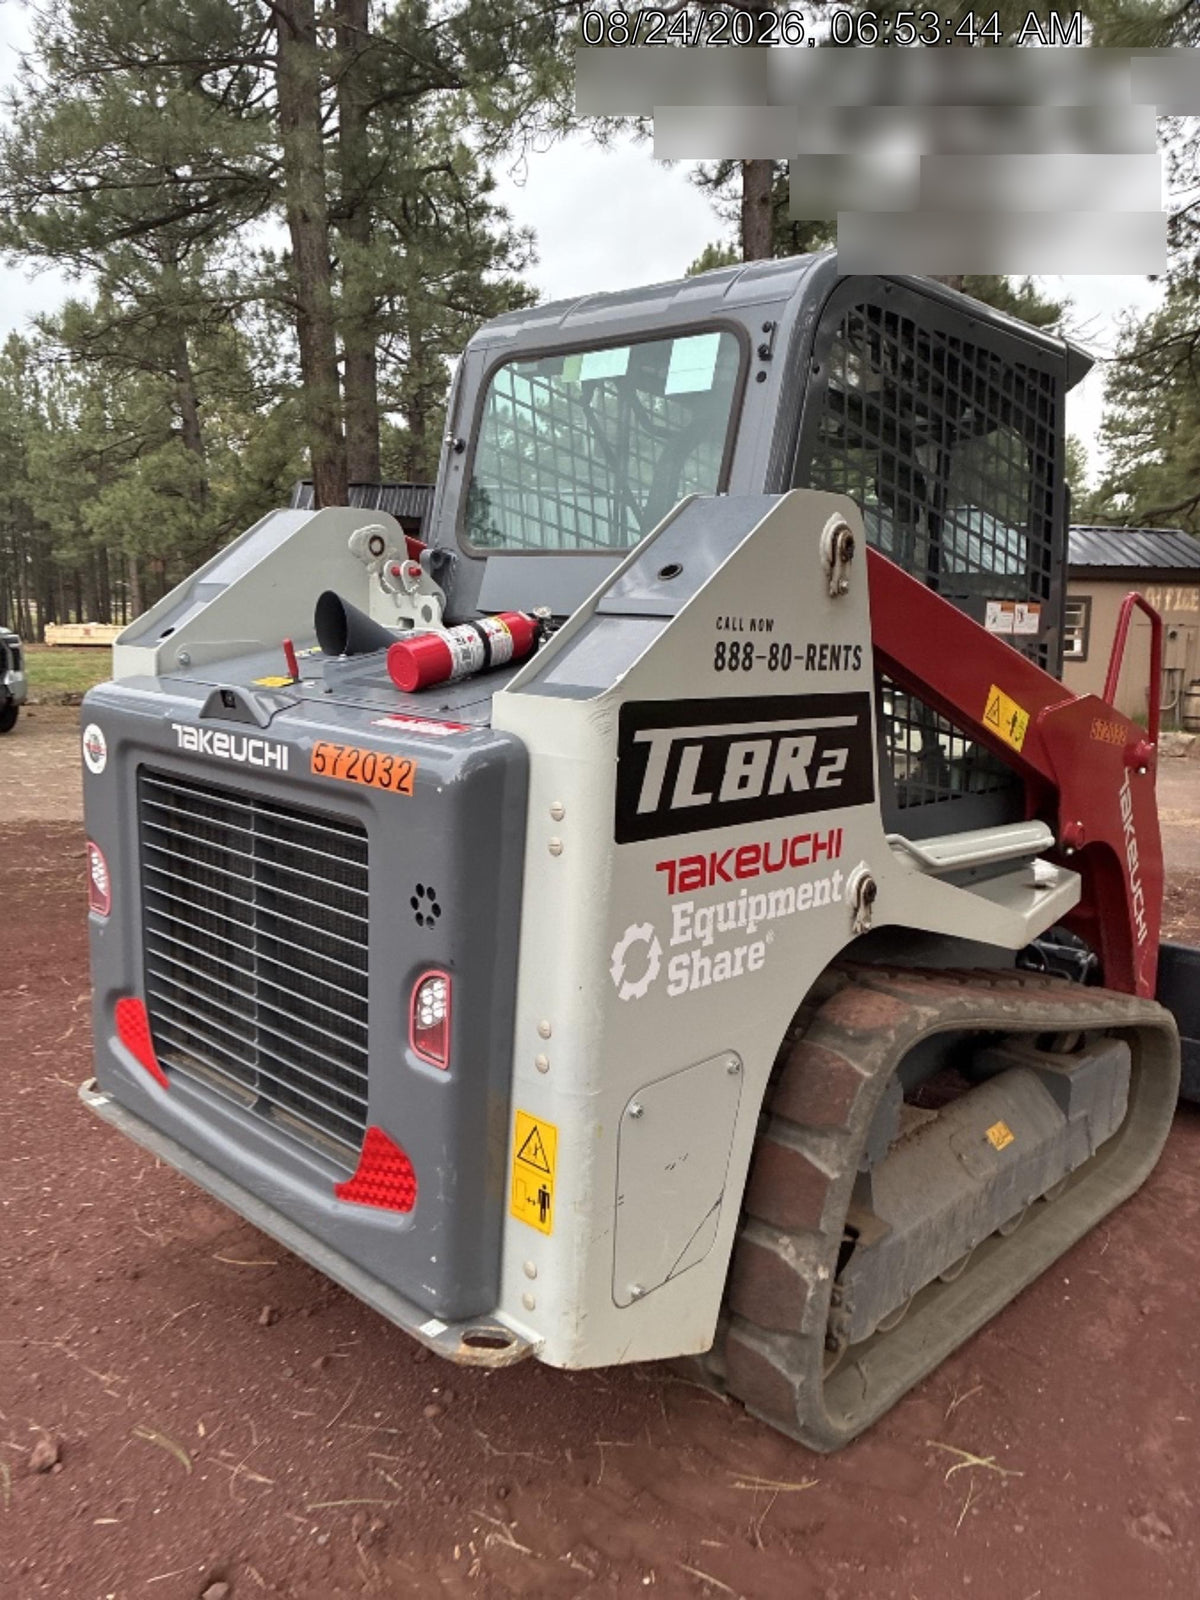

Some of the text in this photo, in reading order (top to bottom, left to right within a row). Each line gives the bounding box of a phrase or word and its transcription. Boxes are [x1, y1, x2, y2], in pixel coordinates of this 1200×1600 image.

[716, 616, 775, 632] CALL NOW
[714, 641, 863, 672] 888-80-RENTS
[313, 742, 413, 793] 572032
[669, 869, 844, 947] Equipment
